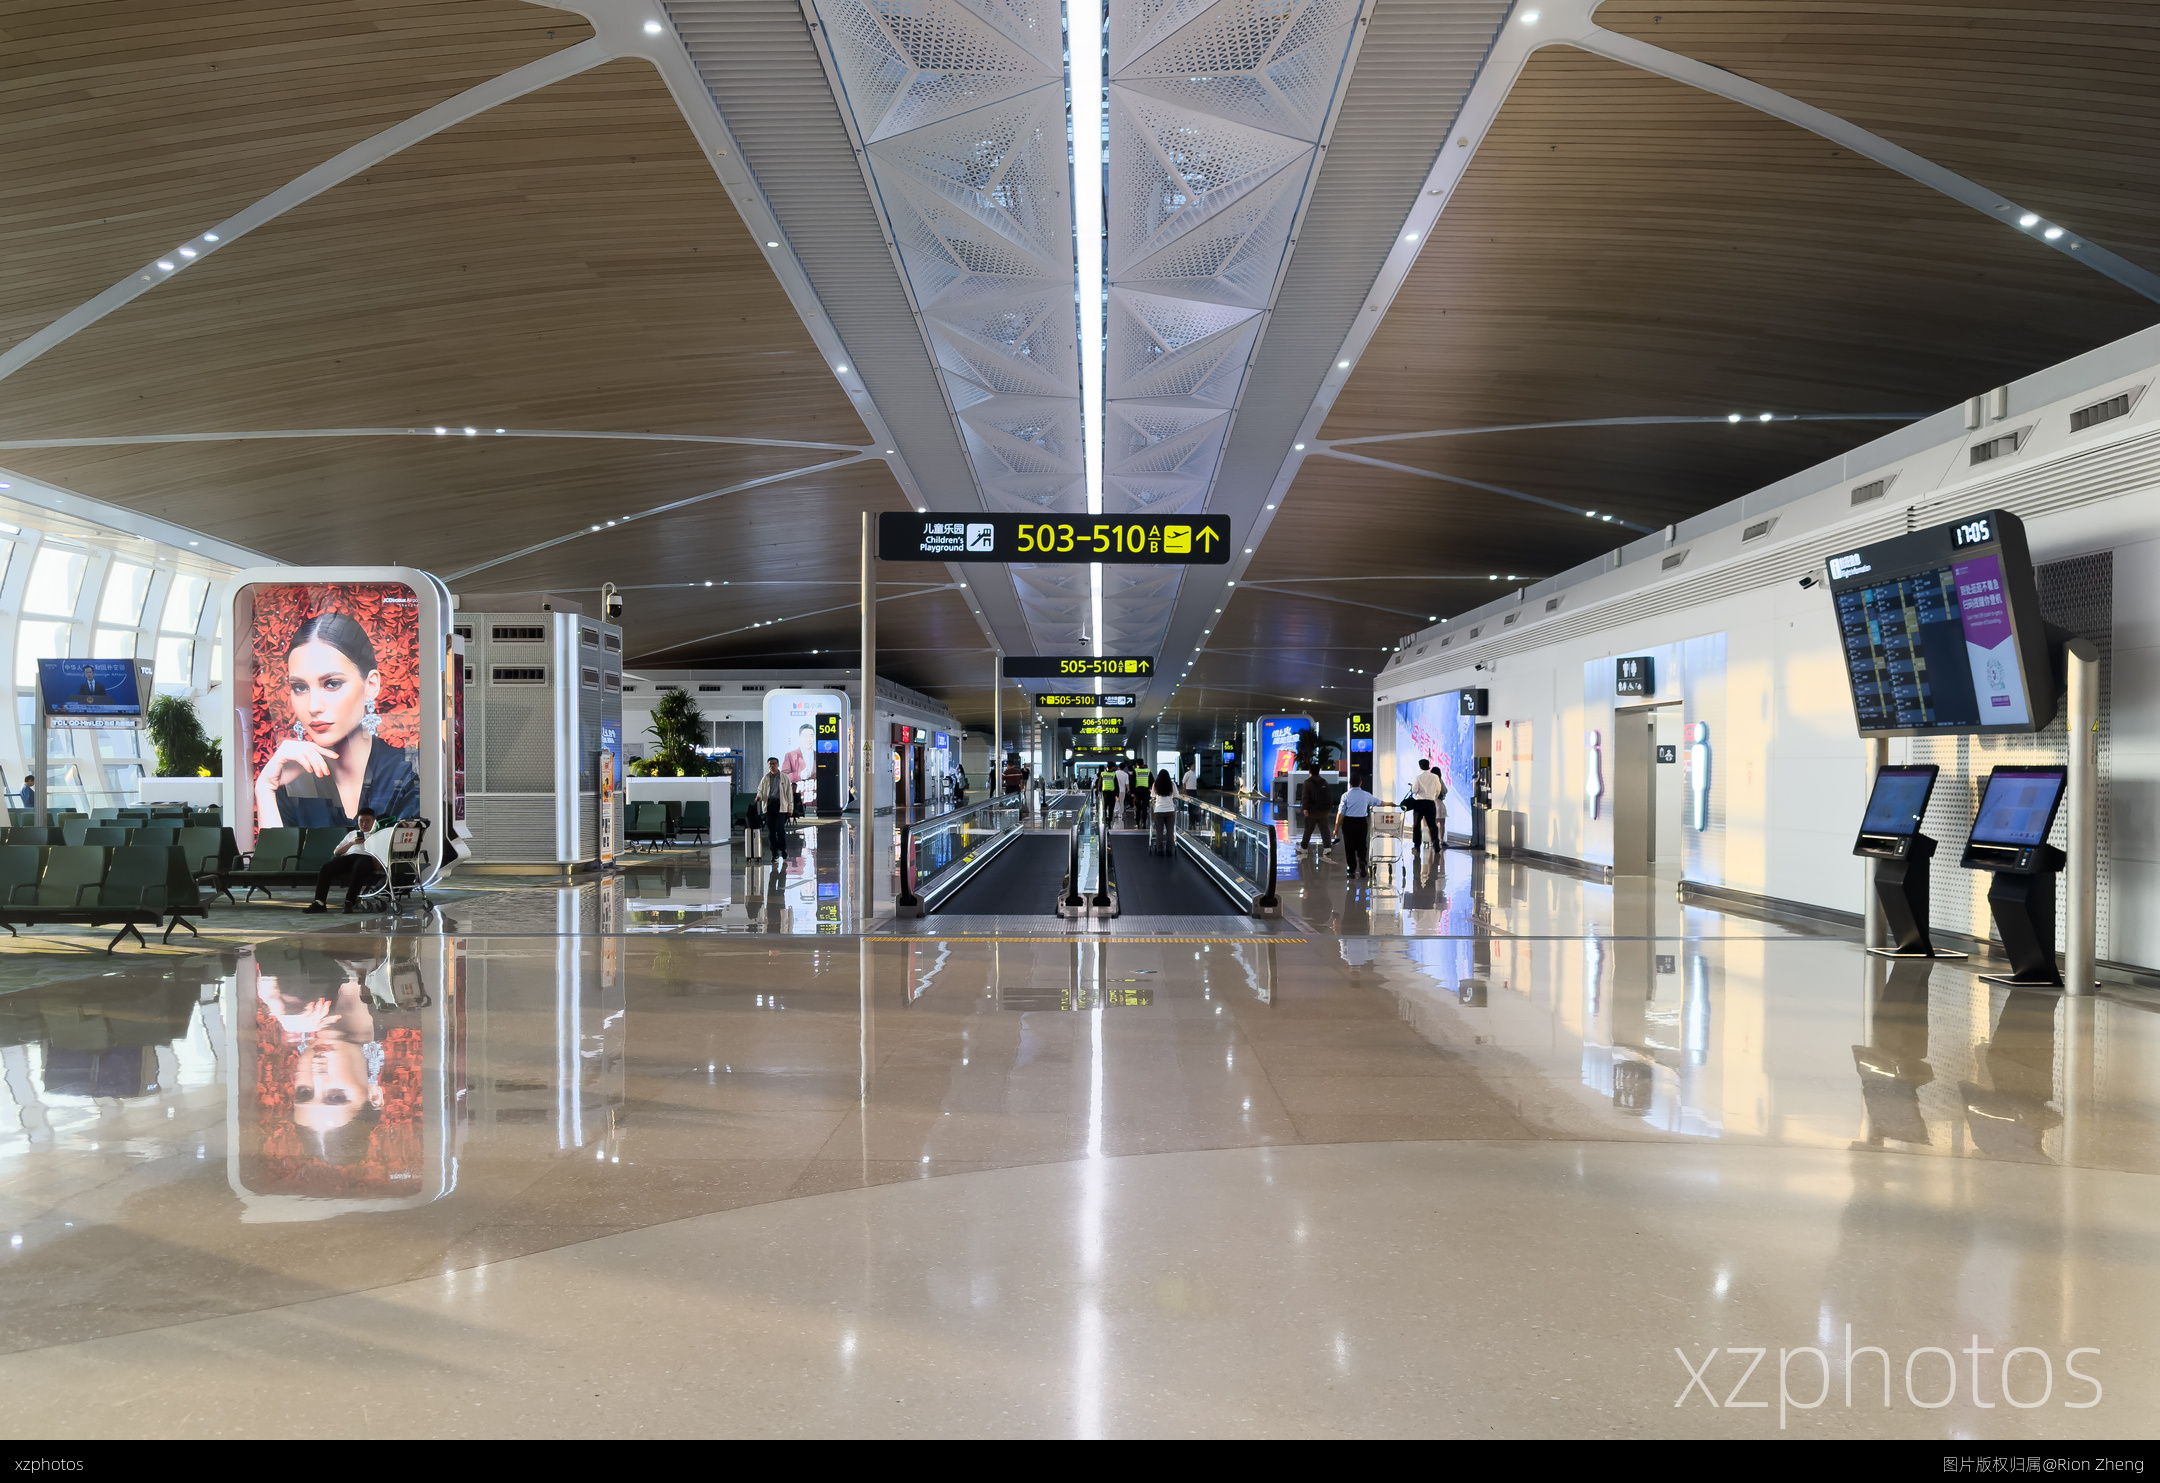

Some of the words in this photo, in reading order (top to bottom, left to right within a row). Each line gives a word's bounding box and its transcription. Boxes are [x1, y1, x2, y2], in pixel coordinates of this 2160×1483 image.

[923, 523, 964, 534] 儿童乐园
[1956, 519, 1990, 545] 17:05
[925, 536, 964, 544] Children's
[1018, 524, 1146, 552] 503-510
[920, 543, 964, 553] Playground
[1060, 660, 1117, 673] 505-510
[1054, 696, 1091, 705] 505-510
[819, 725, 836, 734] 504
[1353, 723, 1371, 733] 503
